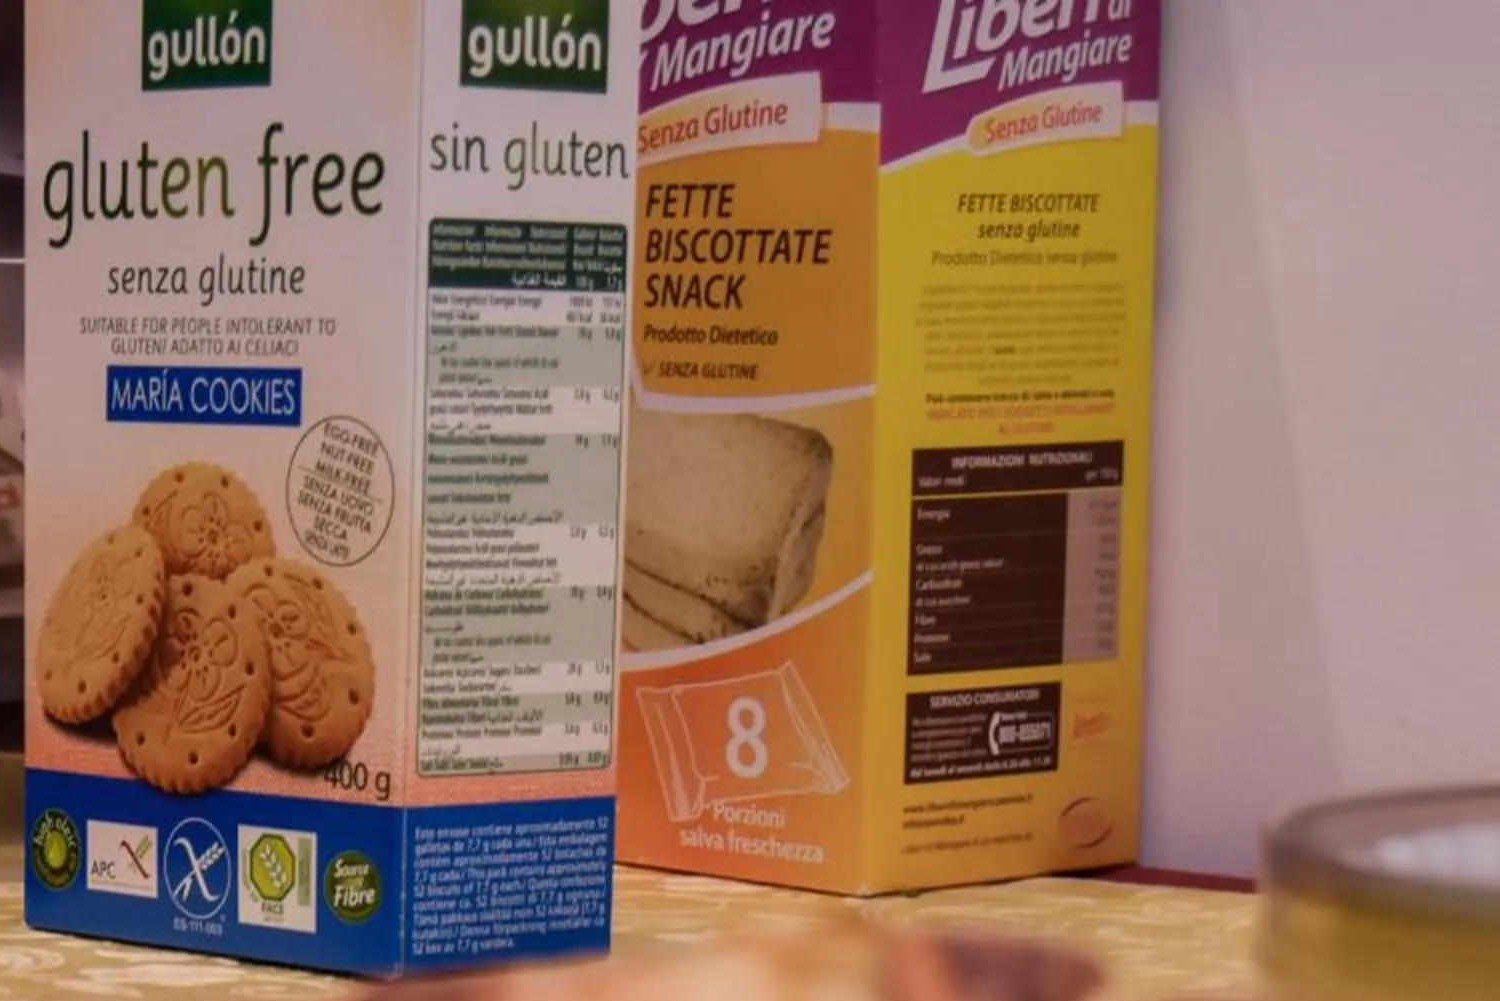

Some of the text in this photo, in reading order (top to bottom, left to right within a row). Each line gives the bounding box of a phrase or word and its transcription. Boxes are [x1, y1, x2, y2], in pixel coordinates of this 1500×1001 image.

[149, 12, 266, 80] gullón
[468, 13, 601, 77] gullón
[650, 11, 835, 92] Mangiare
[997, 29, 1133, 92] Mangiare
[637, 99, 788, 153] Senza Glutine
[984, 102, 1102, 145] Senza Glutine
[429, 120, 628, 191] sin gluten
[43, 122, 385, 249] gluten free
[646, 184, 735, 218] FETTE
[957, 193, 1100, 214] FETTE BISCOTTATE
[645, 229, 832, 264] BISCOTTATE
[978, 219, 1081, 242] senza glutine
[107, 253, 306, 306] senza glutine
[644, 274, 746, 309] SNACK
[79, 317, 336, 337] SUITABLE FOR PEOPLE INTOLERANT TO
[644, 323, 779, 346] Prodotto Dietetico
[171, 339, 223, 357] ADATTO
[659, 362, 759, 380] SENZA GLUTINE
[111, 368, 296, 416] MARÍA COOKIES
[323, 421, 379, 458] EGG FREE
[320, 441, 375, 475] NUT FREE
[298, 490, 332, 515] SENZA
[303, 475, 337, 499] SENZA
[726, 696, 769, 778] 8
[324, 760, 392, 800] 400 g
[714, 802, 786, 829] Porzioni
[680, 823, 824, 864] salva freschezza
[91, 860, 117, 881] APC
[333, 885, 376, 908] Fibre
